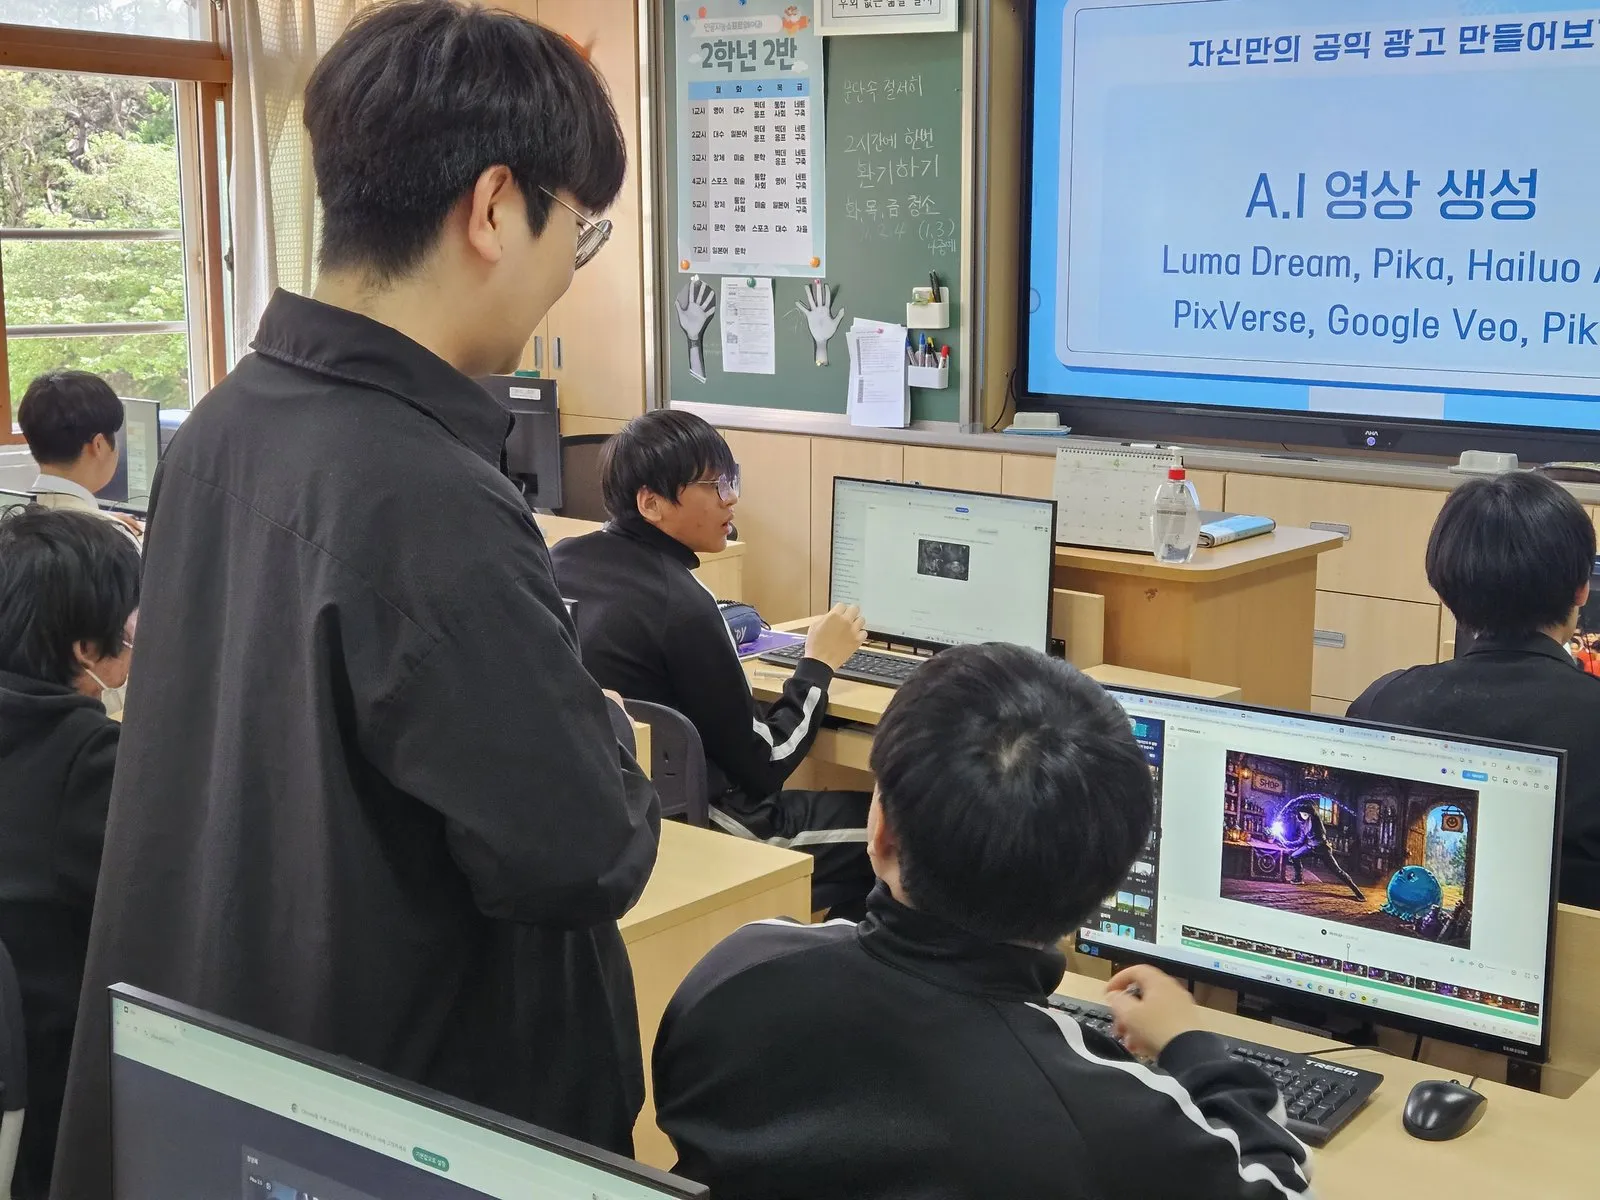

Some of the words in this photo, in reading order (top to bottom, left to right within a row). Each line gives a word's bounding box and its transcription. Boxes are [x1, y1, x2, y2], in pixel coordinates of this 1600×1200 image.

[1188, 35, 1301, 67] 자신만의
[1313, 31, 1371, 62] 공익
[1383, 27, 1447, 58] 광고
[1459, 19, 1600, 54] 만들어보
[700, 39, 757, 73] 2학년
[763, 37, 798, 71] 2반
[692, 107, 706, 115] 1교시
[713, 107, 724, 115] 영어
[733, 106, 745, 114] 대수
[691, 130, 706, 138] 2교시
[713, 130, 725, 138] 대수
[730, 130, 748, 138] 일본어
[844, 131, 897, 155] 2시간에
[904, 127, 935, 150] 한번
[691, 154, 707, 162] 3교시
[733, 153, 745, 162] 미술
[754, 153, 766, 161] 문학
[857, 154, 939, 188] 환기하기
[691, 177, 707, 185] 4교시
[711, 177, 728, 185] 스포츠
[733, 177, 746, 185] 미술
[775, 177, 787, 186] 영어
[1245, 172, 1306, 219] A.I
[1325, 169, 1421, 220] 영상
[1436, 168, 1538, 221] 생성
[692, 200, 708, 208] 5교시
[772, 201, 790, 209] 일본어
[907, 194, 941, 217] 청소
[692, 223, 708, 231] 6교시
[714, 223, 726, 232] 문학
[734, 224, 746, 233] 영어
[752, 224, 769, 233] 스포츠
[775, 225, 788, 233] 대수
[693, 246, 708, 254] 7교시
[1163, 244, 1241, 275] Luma
[1252, 245, 1361, 284] Dream,
[1373, 247, 1454, 286] Pika,
[1468, 248, 1581, 283] Hailuo
[1174, 299, 1315, 339] PixVerse,
[1328, 304, 1440, 344] Google
[1452, 307, 1528, 349] Veo,
[1543, 311, 1599, 346] Pik
[1259, 778, 1281, 789] SHOP
